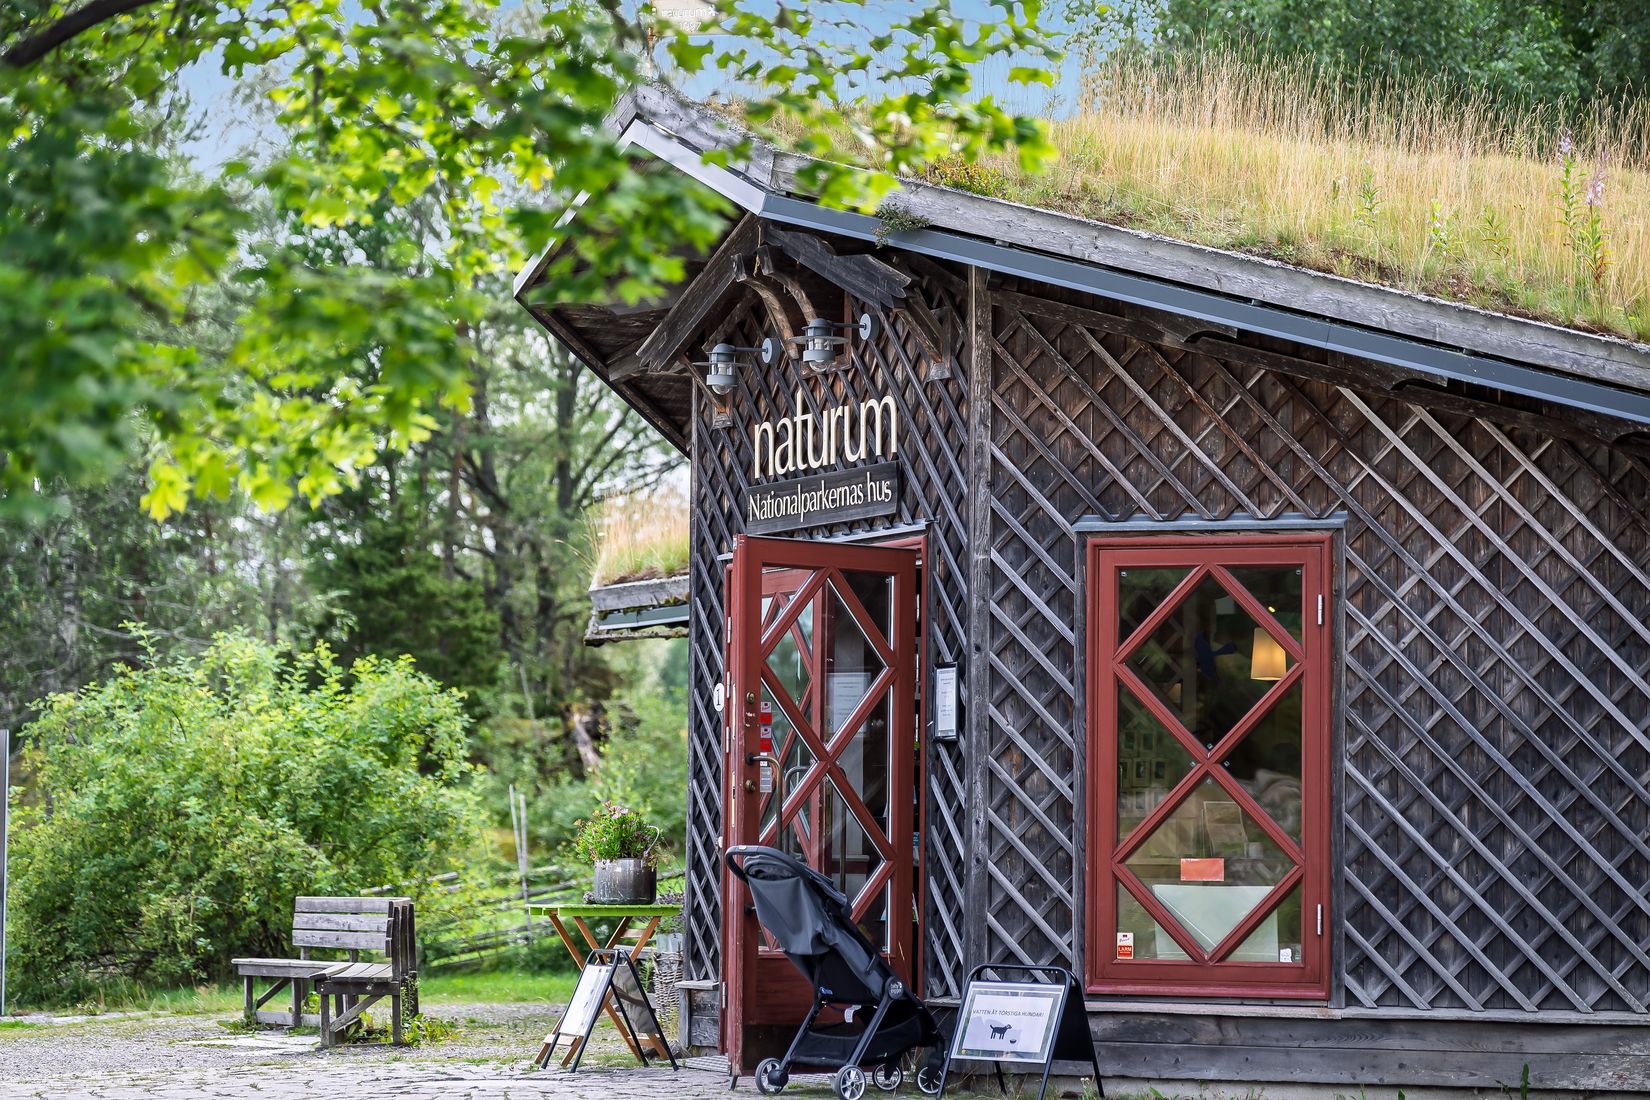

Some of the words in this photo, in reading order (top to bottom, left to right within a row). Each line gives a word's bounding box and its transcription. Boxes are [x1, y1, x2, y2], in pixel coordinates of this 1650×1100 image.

[754, 388, 897, 479] naturum
[749, 480, 864, 522] Nationalparkernas
[866, 472, 892, 503] hus
[716, 688, 721, 706] 1
